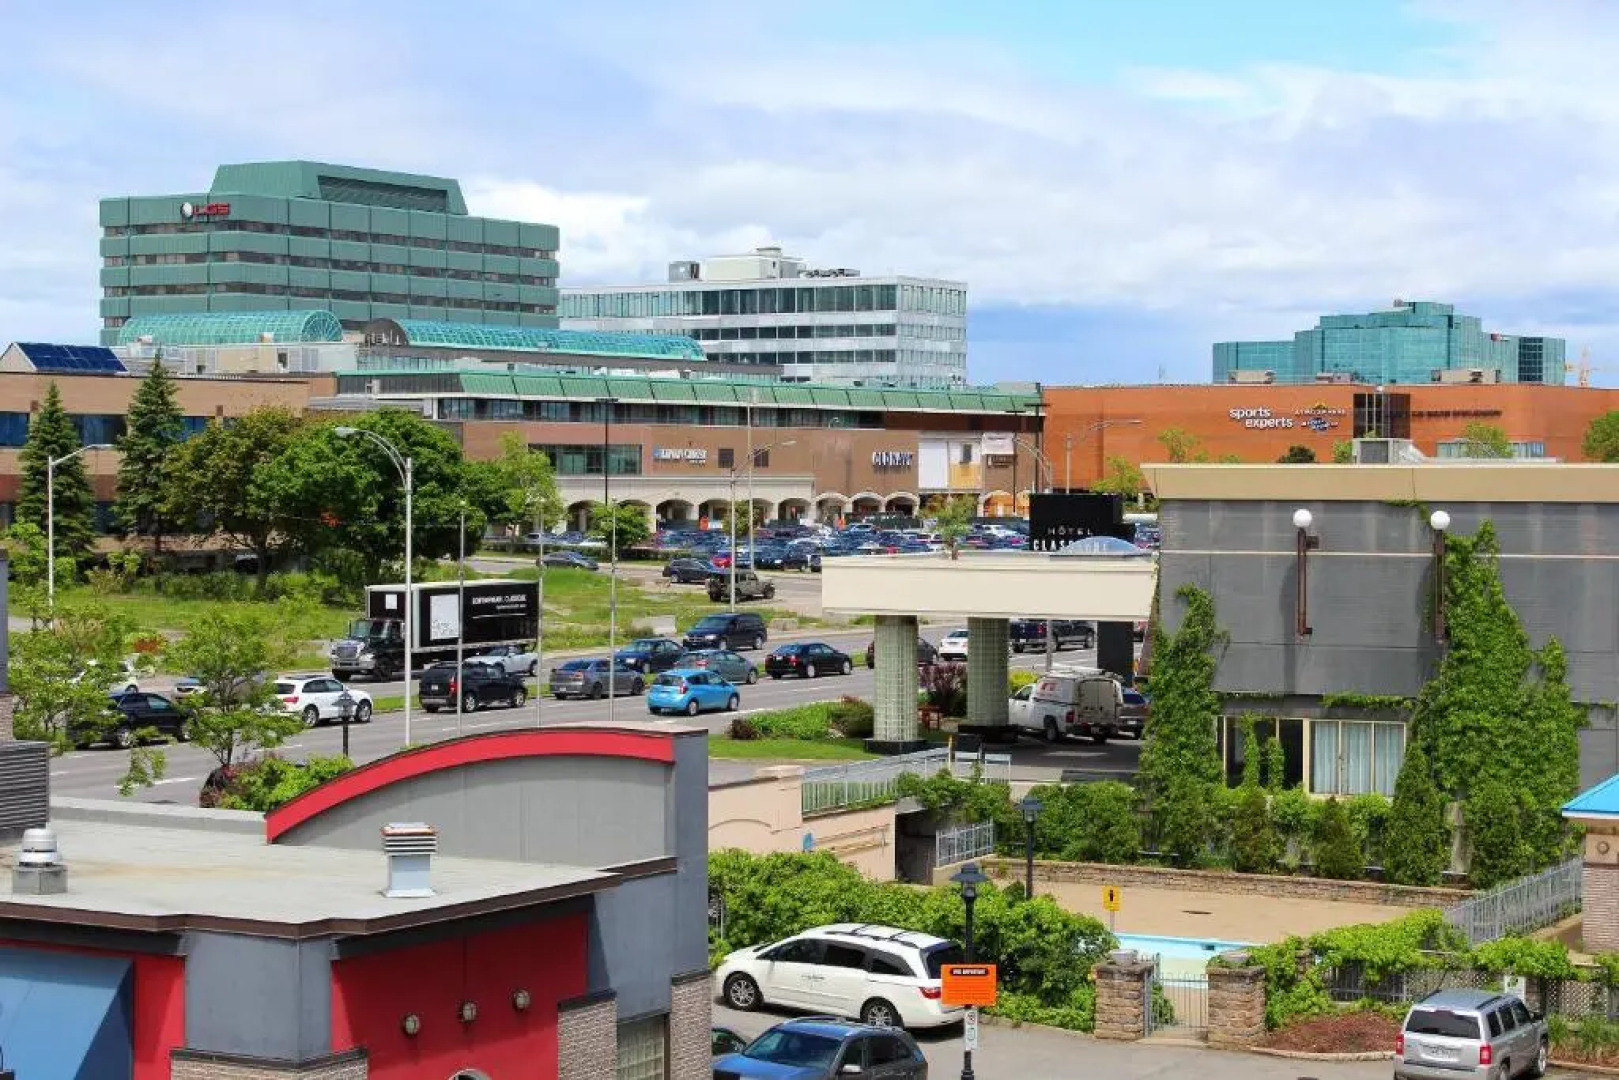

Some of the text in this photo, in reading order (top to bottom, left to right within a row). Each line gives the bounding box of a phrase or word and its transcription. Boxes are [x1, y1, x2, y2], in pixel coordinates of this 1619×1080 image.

[1229, 406, 1271, 419] sports
[1245, 416, 1293, 429] experts
[1047, 525, 1093, 536] HÔTEL
